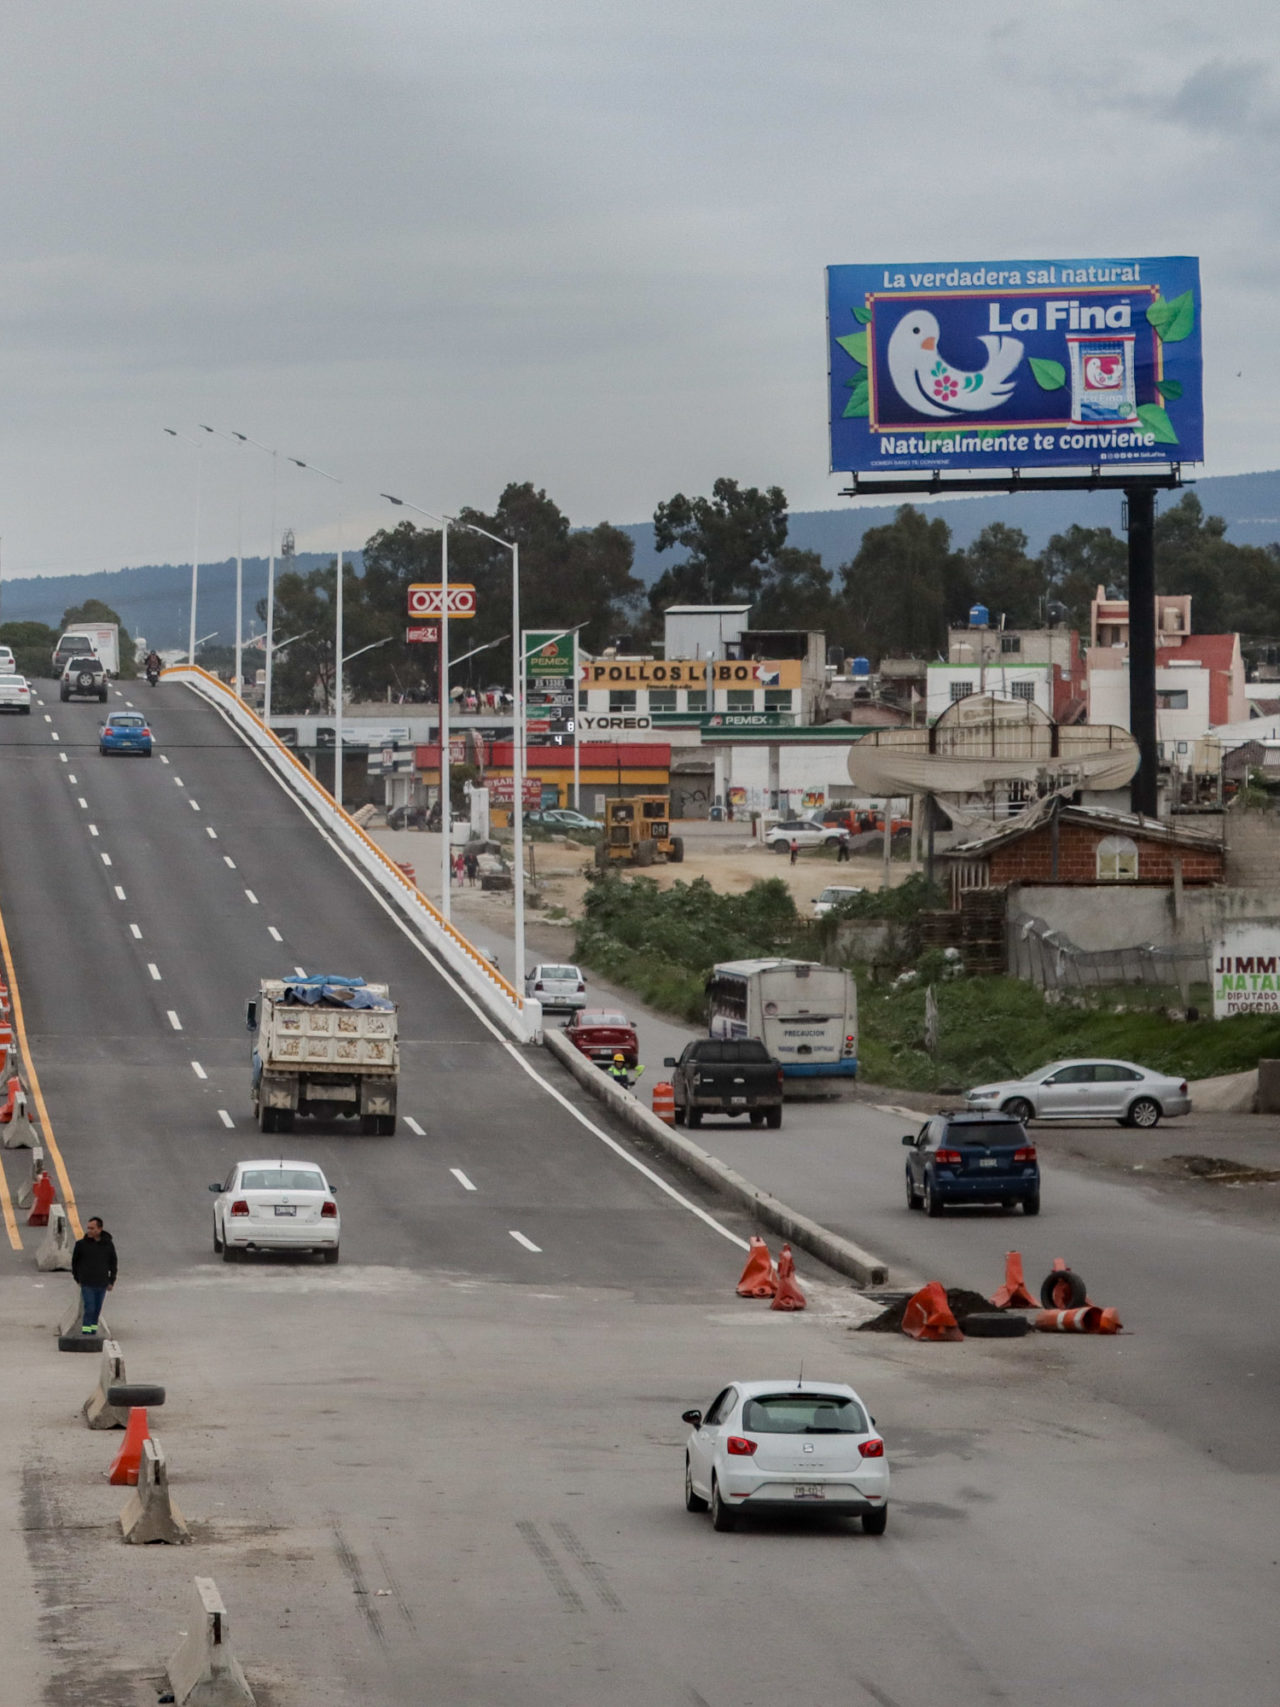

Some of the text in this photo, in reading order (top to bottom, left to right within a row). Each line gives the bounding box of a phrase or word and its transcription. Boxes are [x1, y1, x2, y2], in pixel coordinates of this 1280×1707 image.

[883, 264, 1141, 288] La verdadera sal natural
[989, 300, 1131, 332] La Fina
[880, 429, 1155, 455] Naturalmente te conviene
[412, 592, 473, 610] OXXO
[594, 666, 682, 682] POLLOS
[726, 716, 767, 725] PEMEX
[1216, 956, 1280, 974] JIMM
[1227, 992, 1278, 1001] DIPUTADO
[1227, 1001, 1279, 1014] morena
